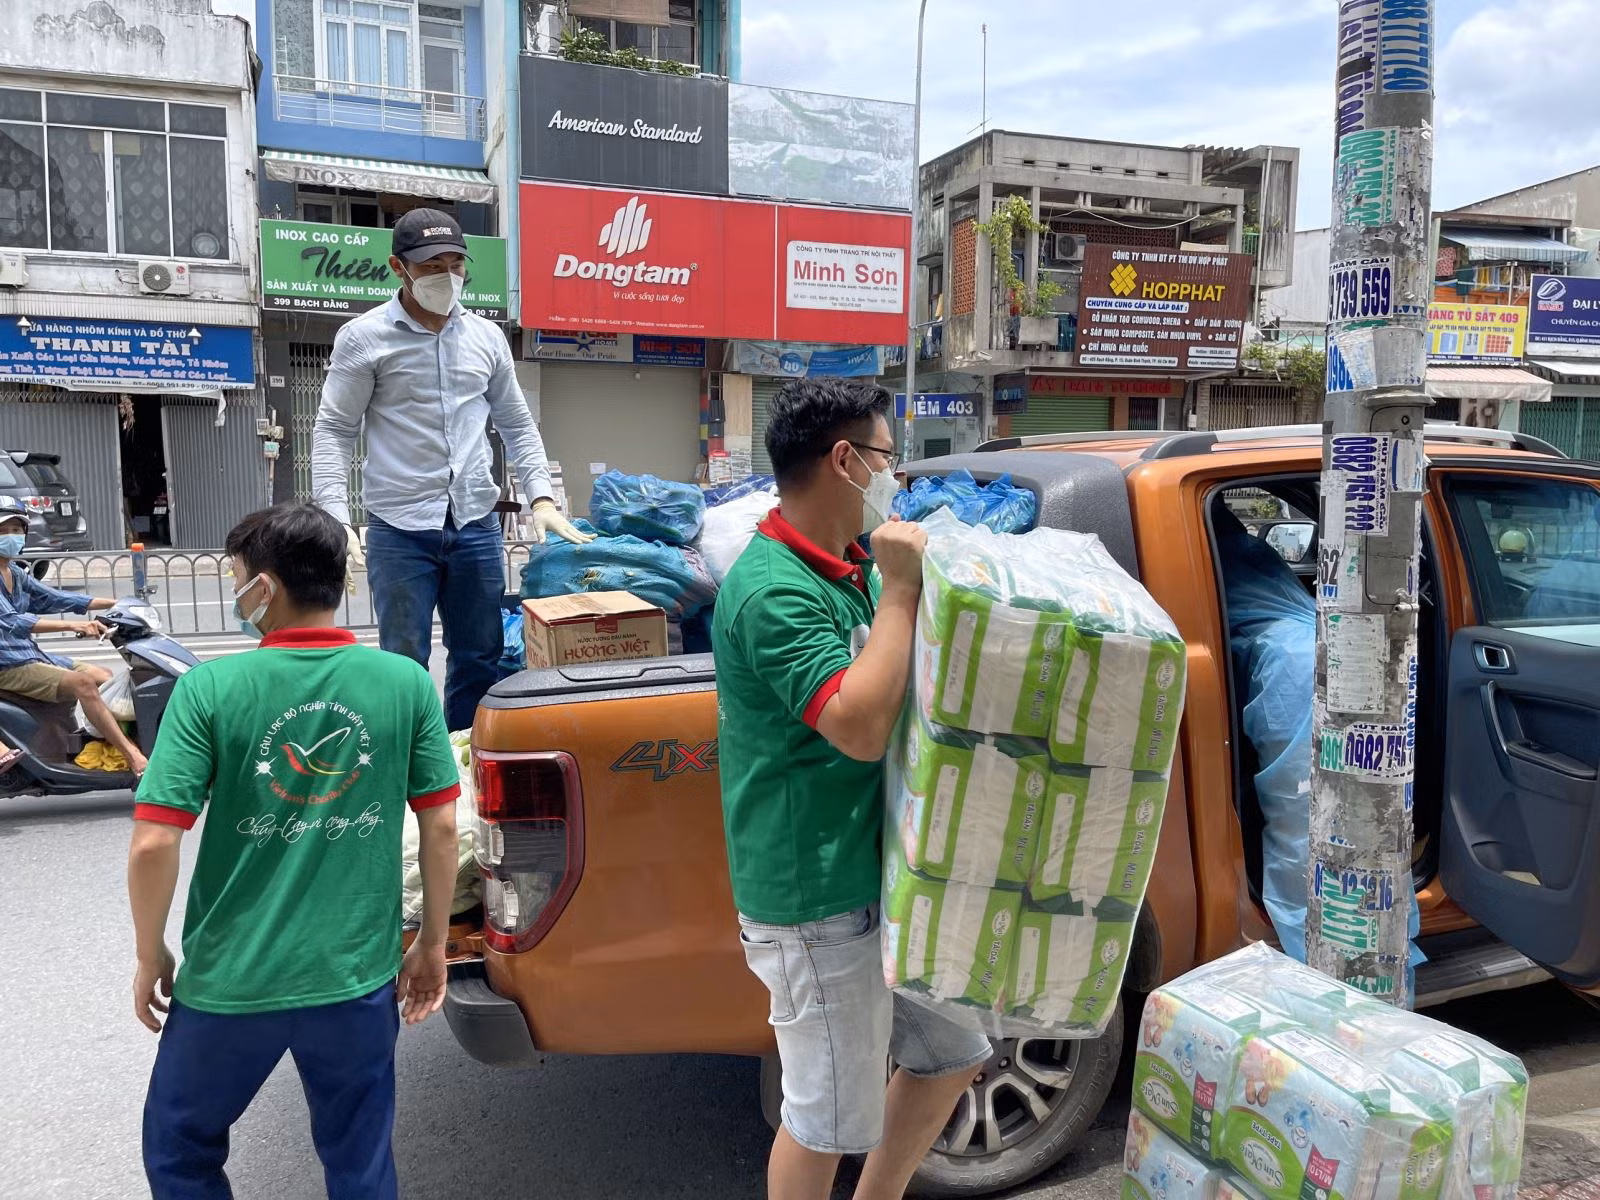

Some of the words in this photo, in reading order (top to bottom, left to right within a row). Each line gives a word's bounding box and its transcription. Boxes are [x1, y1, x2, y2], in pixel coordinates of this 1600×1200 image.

[548, 109, 627, 138] American
[630, 118, 703, 144] Standard
[293, 166, 354, 186] INOX
[275, 228, 307, 241] INOX
[312, 232, 339, 244] CAO
[344, 232, 369, 246] CẤP
[796, 244, 813, 253] CÔNG
[840, 248, 860, 256] TRANG
[1112, 250, 1130, 260] CÔNG
[1131, 252, 1140, 261] TY
[301, 246, 390, 282] Thiên
[553, 254, 691, 288] Dongtam
[793, 260, 845, 282] Minh
[855, 263, 898, 285] Sơn
[266, 279, 288, 291] SẢN
[291, 279, 319, 293] XUẤT
[322, 282, 337, 294] VÀ
[339, 285, 364, 296] KINH
[478, 293, 501, 303] INOX
[1142, 281, 1226, 302] HOPPHAT
[274, 298, 291, 306] 399
[294, 299, 320, 309] BẠCH
[322, 298, 349, 309] ĐẰNG
[1087, 299, 1114, 308] CHUYÊN
[1114, 300, 1133, 309] CUNG
[1572, 299, 1591, 310] ĐẠI
[1499, 312, 1519, 324] 409
[45, 323, 73, 333] HÀNG
[75, 324, 105, 335] NHÔM
[107, 325, 131, 337] KÍNH
[133, 327, 147, 337] VÀ
[166, 329, 187, 339] THỜ
[30, 337, 131, 354] THANH
[140, 339, 191, 356] TÀI
[555, 350, 576, 359] Home
[582, 351, 595, 360] Our
[597, 351, 617, 360] Pride
[35, 351, 55, 362] Các
[912, 395, 940, 416] ẺM
[946, 401, 974, 415] 403
[564, 644, 617, 660] HƯƠNG
[619, 638, 651, 653] VIỆT
[260, 735, 273, 756] CÂU
[267, 717, 286, 736] LẠC
[284, 707, 297, 721] BỘ
[299, 700, 326, 713] NGHĨA
[328, 701, 348, 716] TÌNH
[347, 710, 364, 727] ĐẤT
[359, 727, 373, 748] VIỆT
[281, 812, 310, 843] tay
